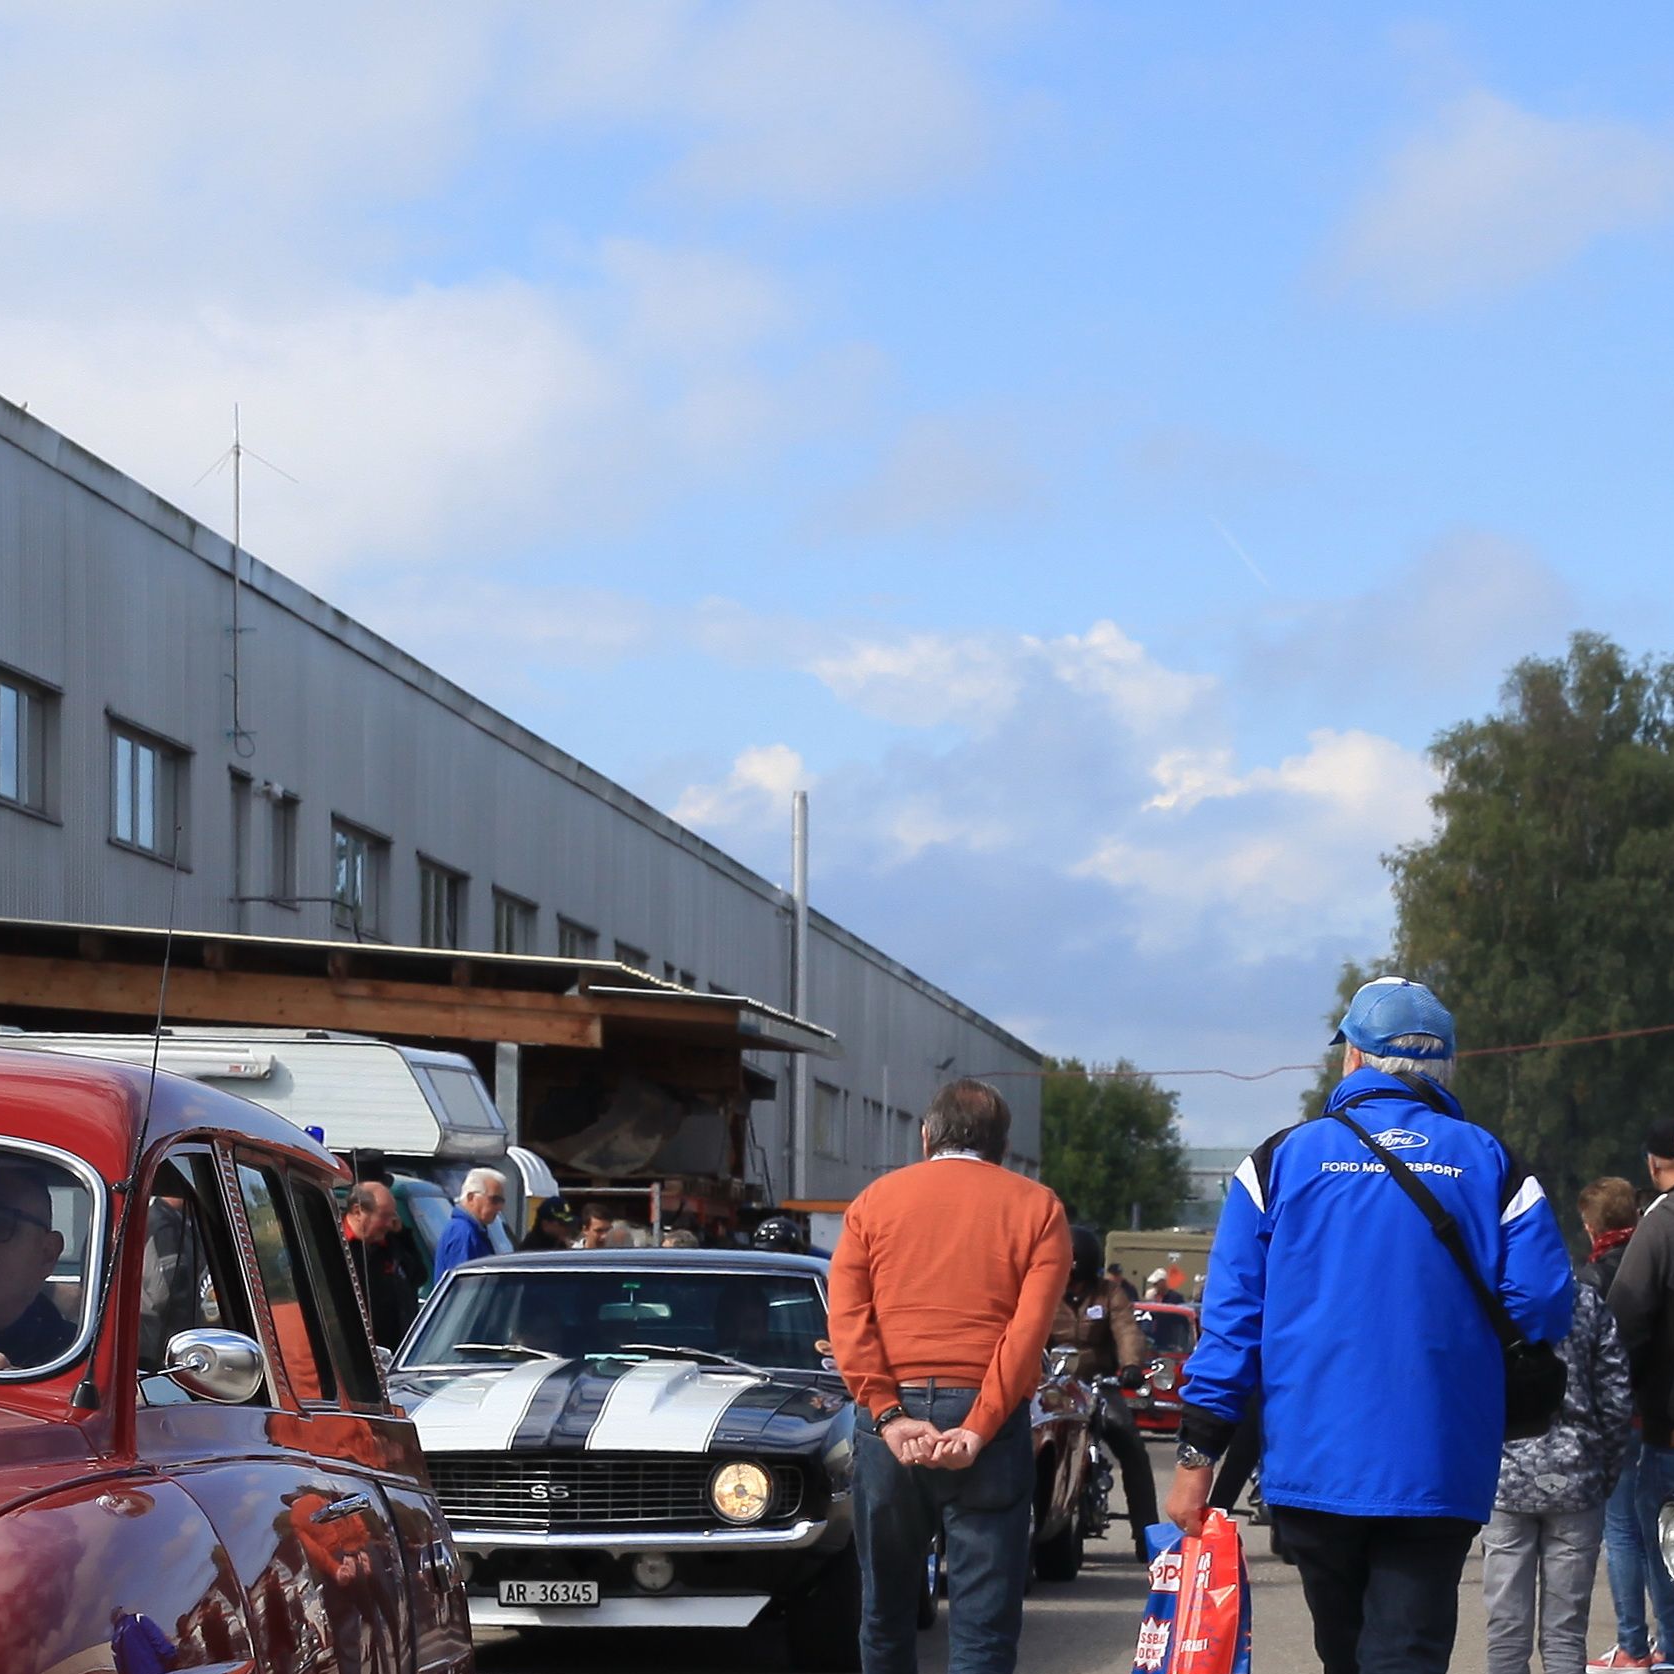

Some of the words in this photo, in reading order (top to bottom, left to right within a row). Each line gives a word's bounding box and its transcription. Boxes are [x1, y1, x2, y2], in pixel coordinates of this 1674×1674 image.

[1321, 1162, 1359, 1173] FORD
[1362, 1162, 1463, 1178] MORSPORT
[530, 1484, 569, 1499] SS
